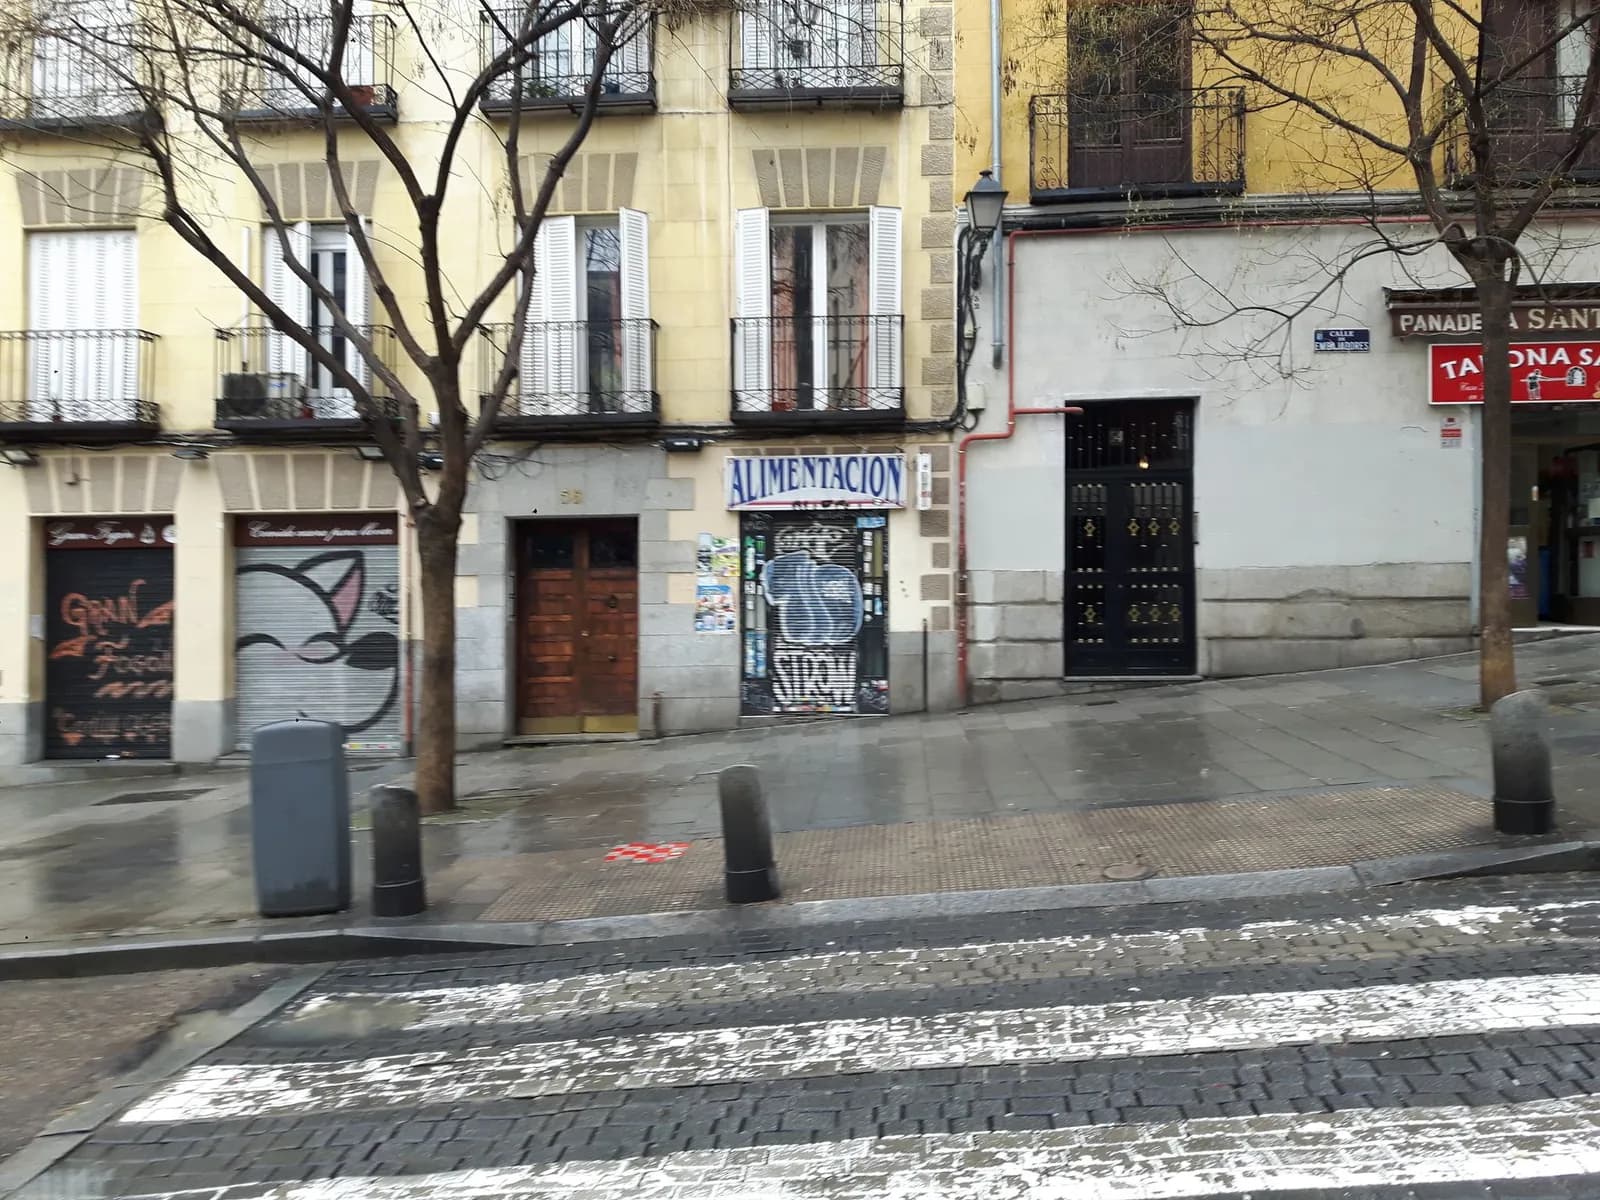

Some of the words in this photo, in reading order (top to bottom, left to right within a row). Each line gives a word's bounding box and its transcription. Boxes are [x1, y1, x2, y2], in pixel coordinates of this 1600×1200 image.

[1400, 311, 1519, 332] PANADEA
[1440, 347, 1572, 380] TAONA
[729, 455, 904, 508] ALIMENTACION
